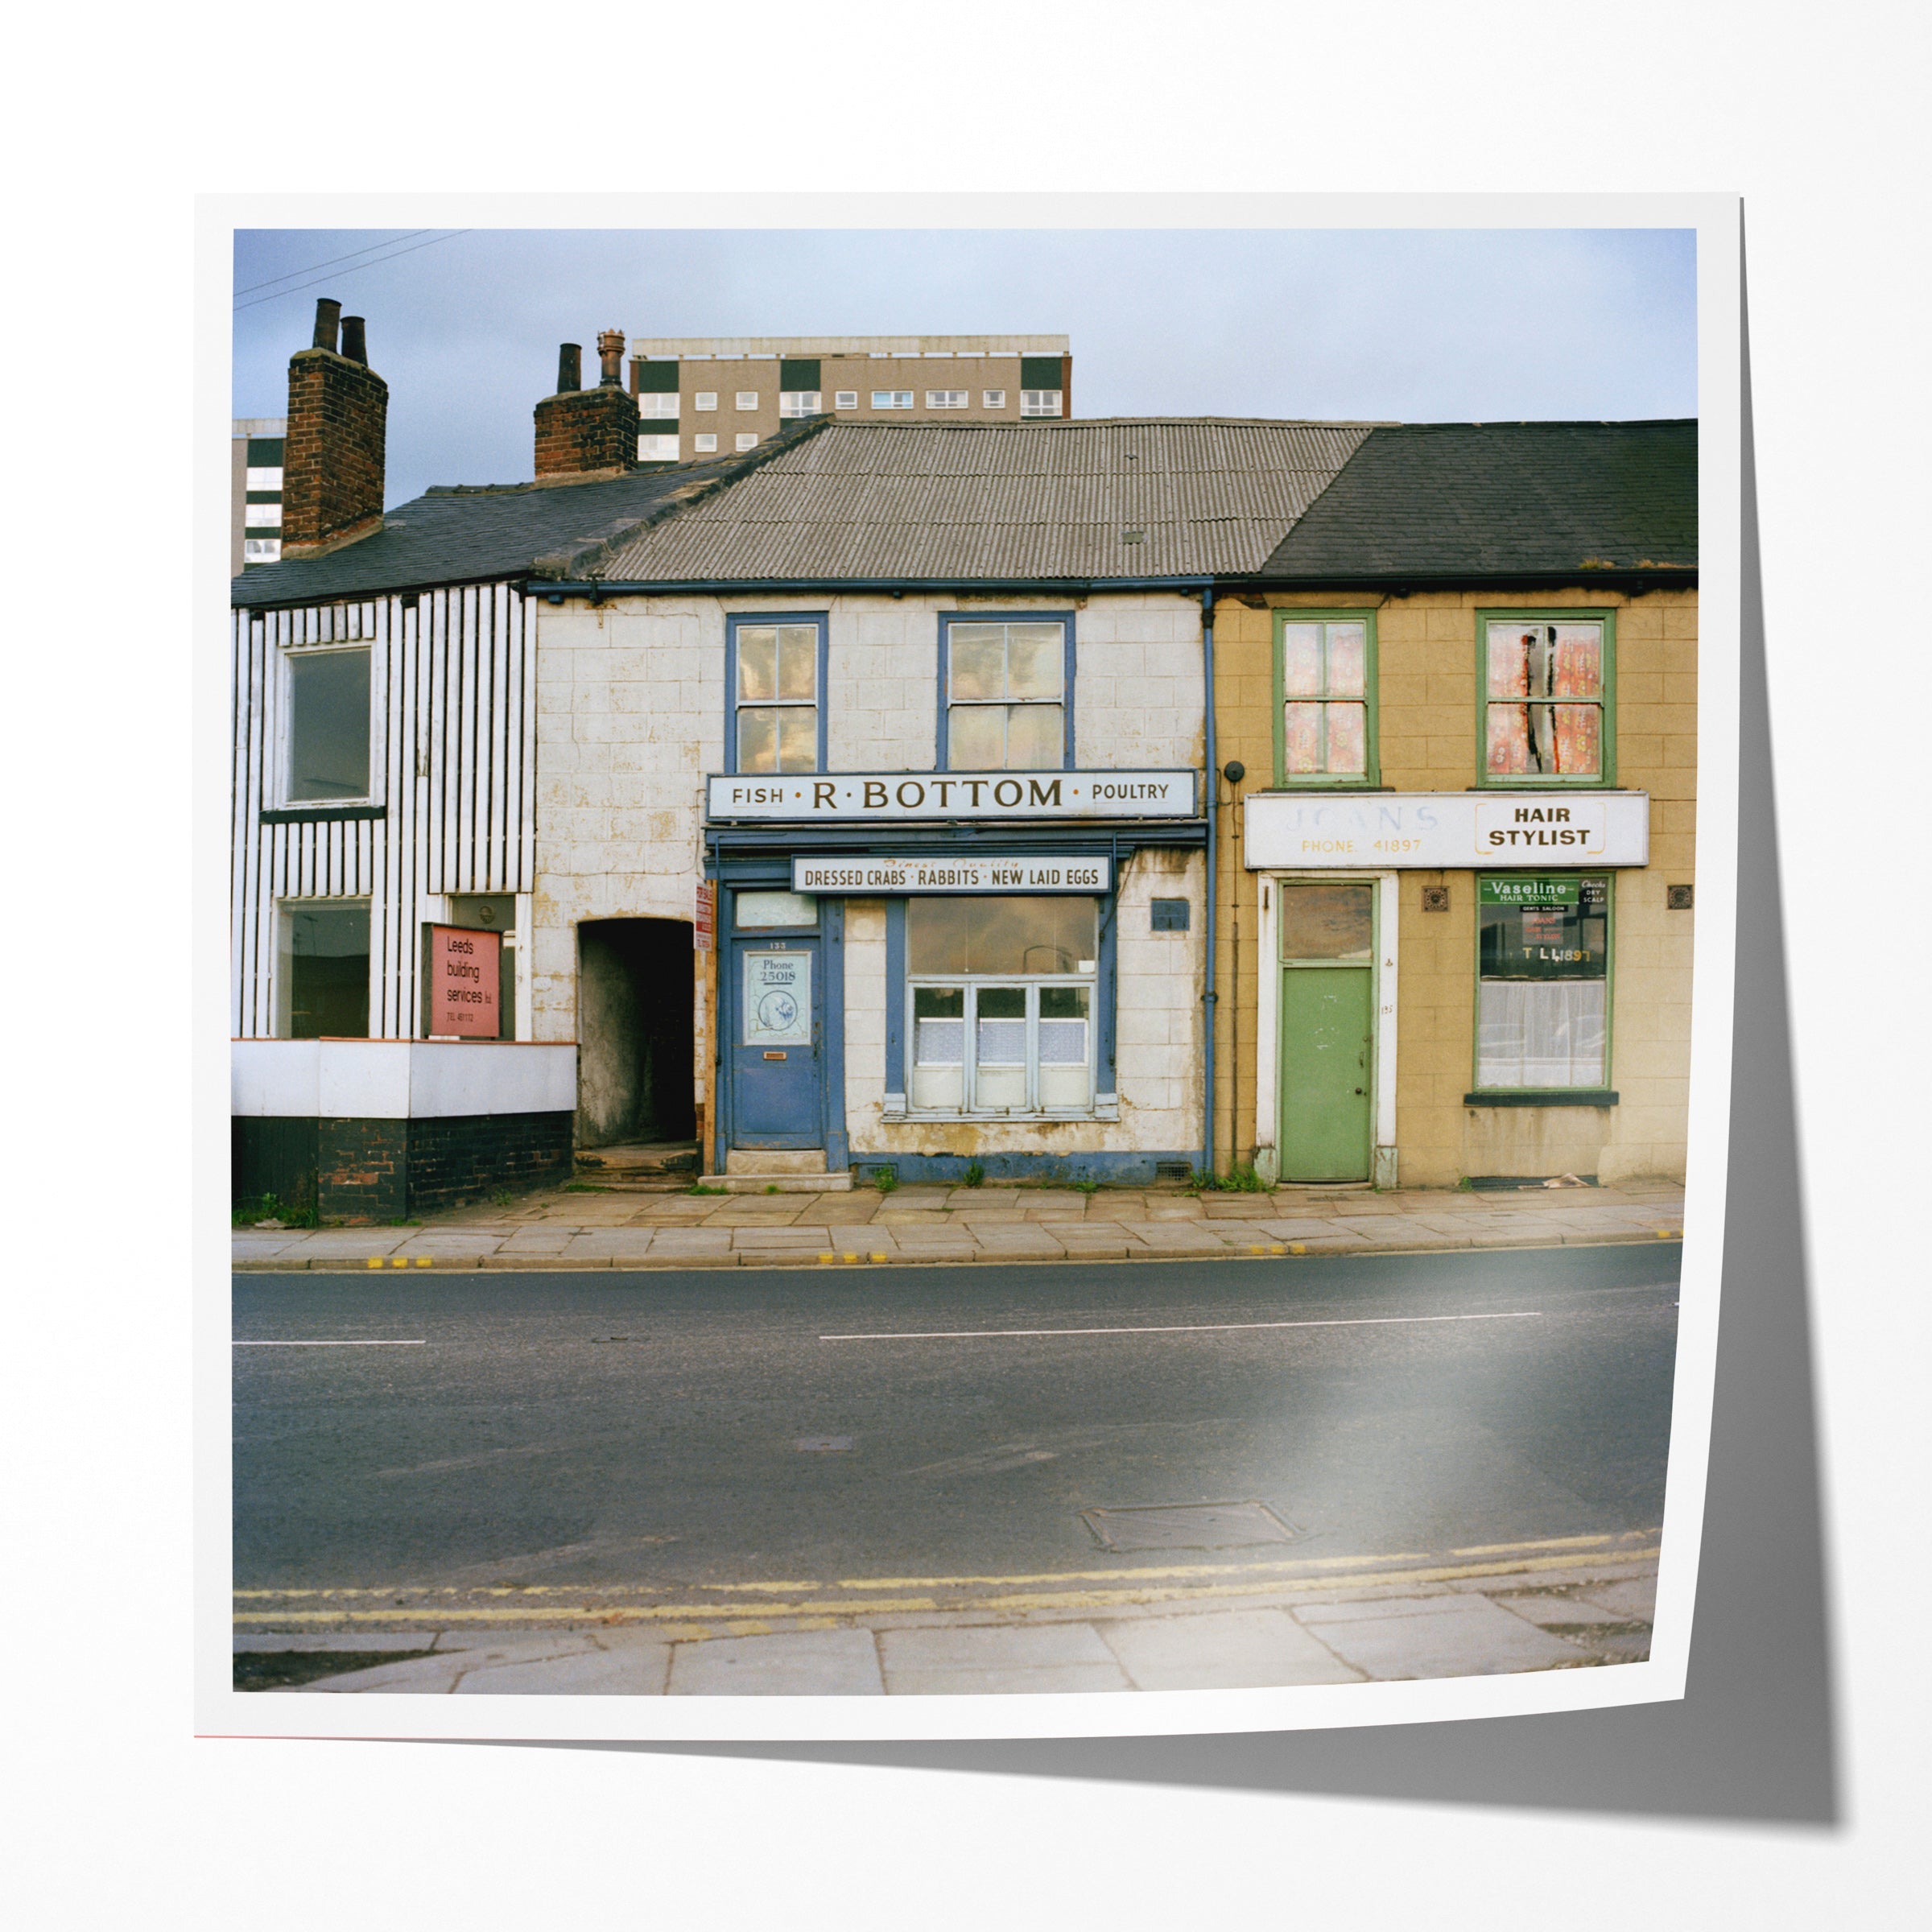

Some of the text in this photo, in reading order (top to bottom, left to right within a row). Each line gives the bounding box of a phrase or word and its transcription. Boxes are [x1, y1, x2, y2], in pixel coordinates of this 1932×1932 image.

[732, 778, 1170, 809] FISH R BOTTOM POULTRY
[1514, 807, 1571, 823] HAIR
[1373, 839, 1422, 852] 41897
[1488, 829, 1591, 846] STYLIST
[805, 869, 1099, 886] DRESSED CRABS RABBITS NEW LAID EGGS
[1492, 881, 1567, 894] Vaseline
[447, 935, 473, 955] Leeds
[770, 942, 786, 950] 133
[447, 960, 480, 984] building
[763, 960, 794, 970] Phone
[760, 972, 796, 981] 25018
[447, 987, 482, 1004] services
